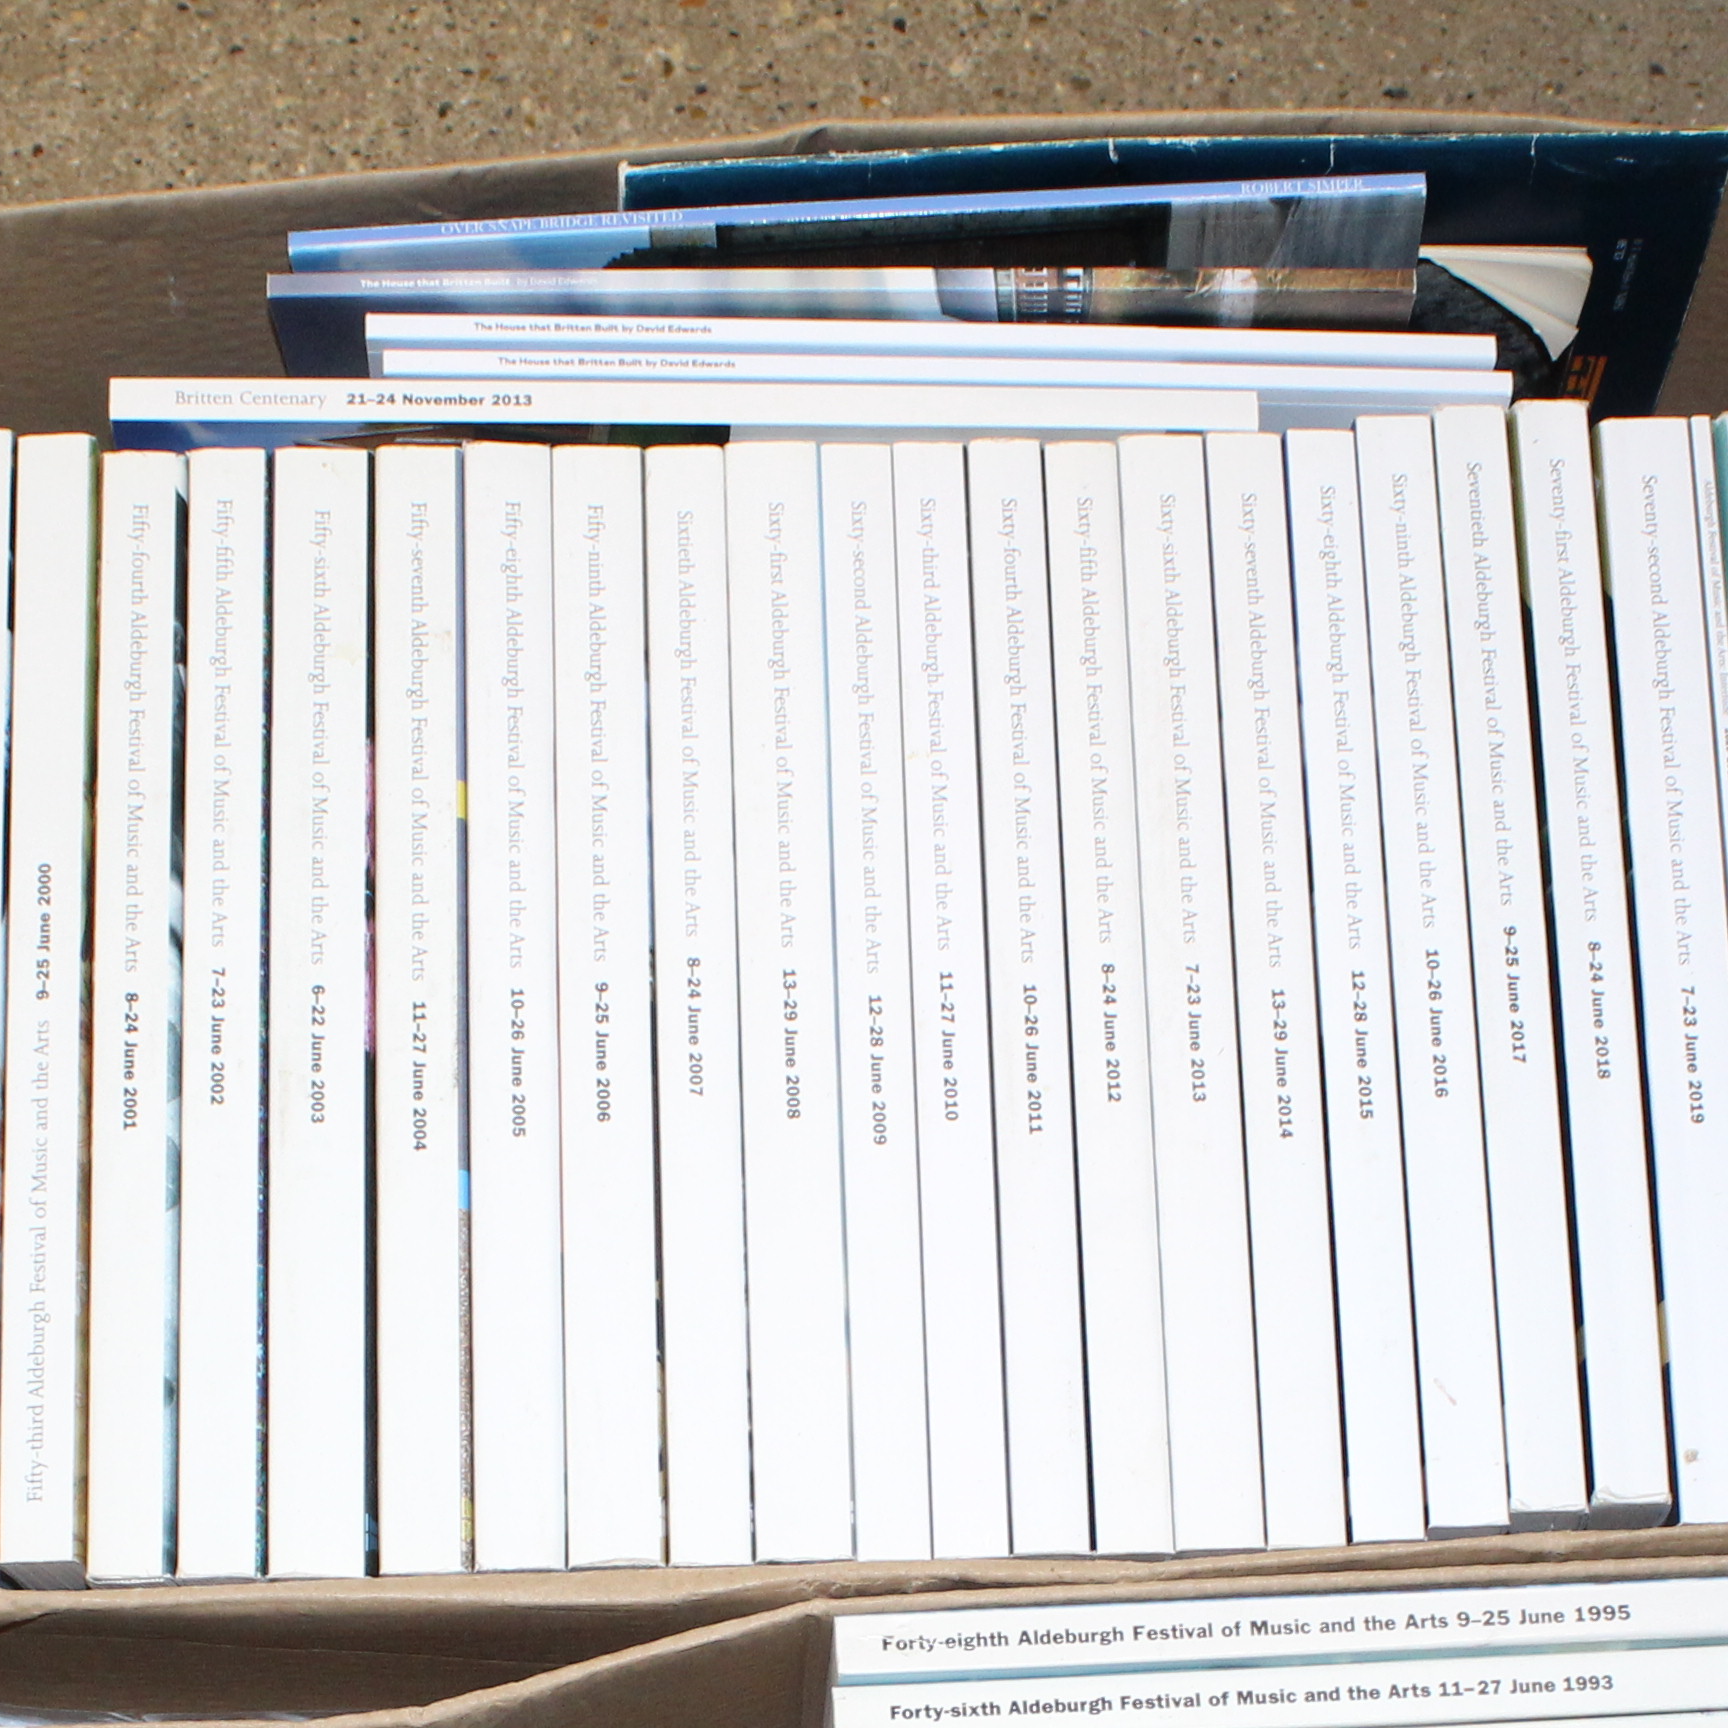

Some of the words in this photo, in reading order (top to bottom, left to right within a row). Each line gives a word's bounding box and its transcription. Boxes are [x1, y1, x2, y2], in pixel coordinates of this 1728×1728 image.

[1241, 180, 1304, 195] ROBERT
[1307, 178, 1364, 192] SIMPER
[440, 222, 484, 235] OVER
[540, 215, 599, 230] BRIDGE
[601, 210, 684, 227] REVISITED
[474, 322, 493, 331] The
[495, 323, 527, 331] House
[554, 323, 592, 332] Britten
[594, 324, 618, 332] Built
[636, 324, 666, 333] David
[667, 325, 712, 333] Edwards
[175, 391, 233, 405] Britten
[240, 391, 327, 410] Centenary
[347, 393, 396, 406] 21–24
[402, 393, 485, 406] November
[492, 394, 532, 406] 2013
[677, 511, 695, 575] Sixtieth
[674, 579, 697, 670] Aldeburgh
[680, 677, 699, 739] Festival
[682, 746, 700, 767] of
[682, 771, 699, 823] Music
[684, 830, 701, 862] and
[37, 863, 51, 906] 2000
[684, 869, 702, 896] the
[37, 913, 51, 952] June
[685, 901, 701, 937] Arts
[36, 959, 50, 1000] 9–25
[687, 957, 701, 999] 8–24
[33, 1020, 49, 1056] Arts
[688, 1005, 701, 1045] June
[31, 1062, 49, 1090] the
[689, 1053, 703, 1096] 2007
[31, 1097, 48, 1130] and
[31, 1138, 48, 1192] Music
[29, 1198, 47, 1219] of
[29, 1226, 46, 1293] Festival
[27, 1301, 51, 1398] Aldeburgh
[25, 1404, 48, 1502] Fifty-third
[882, 1631, 1009, 1652] Forty-eighth
[1018, 1627, 1124, 1646] Aldeburgh
[1133, 1623, 1213, 1641] Festival
[1221, 1621, 1241, 1637] of
[1250, 1619, 1310, 1636] Music
[1319, 1617, 1355, 1633] and
[1363, 1616, 1396, 1631] the
[1405, 1614, 1449, 1629] Arts
[1457, 1610, 1510, 1627] 9–25
[1519, 1609, 1565, 1625] June
[1575, 1604, 1631, 1622] 1995
